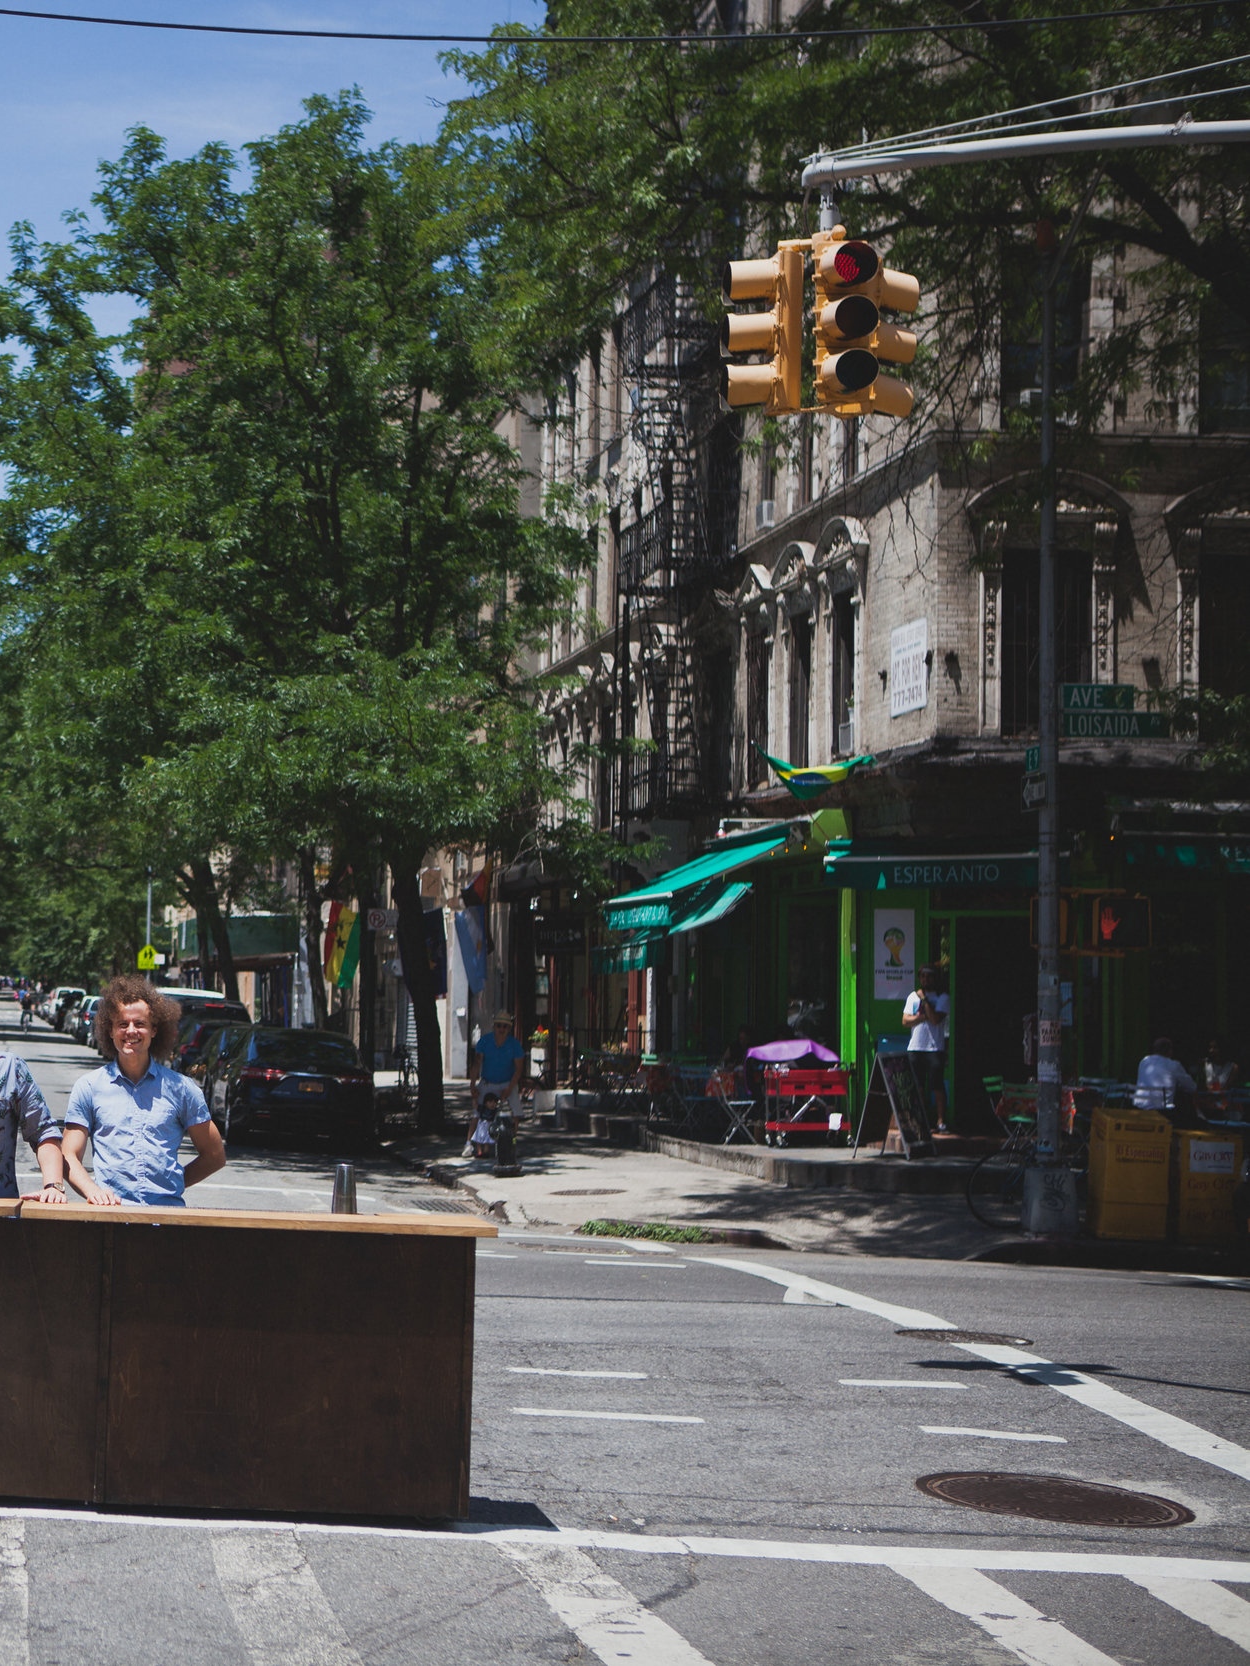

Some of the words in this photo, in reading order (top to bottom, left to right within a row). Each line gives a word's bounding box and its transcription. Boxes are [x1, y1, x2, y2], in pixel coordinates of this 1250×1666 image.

[1069, 687, 1104, 707] AVE
[1069, 715, 1140, 736] LOISAIDA
[893, 864, 1000, 884] ESPERANTO
